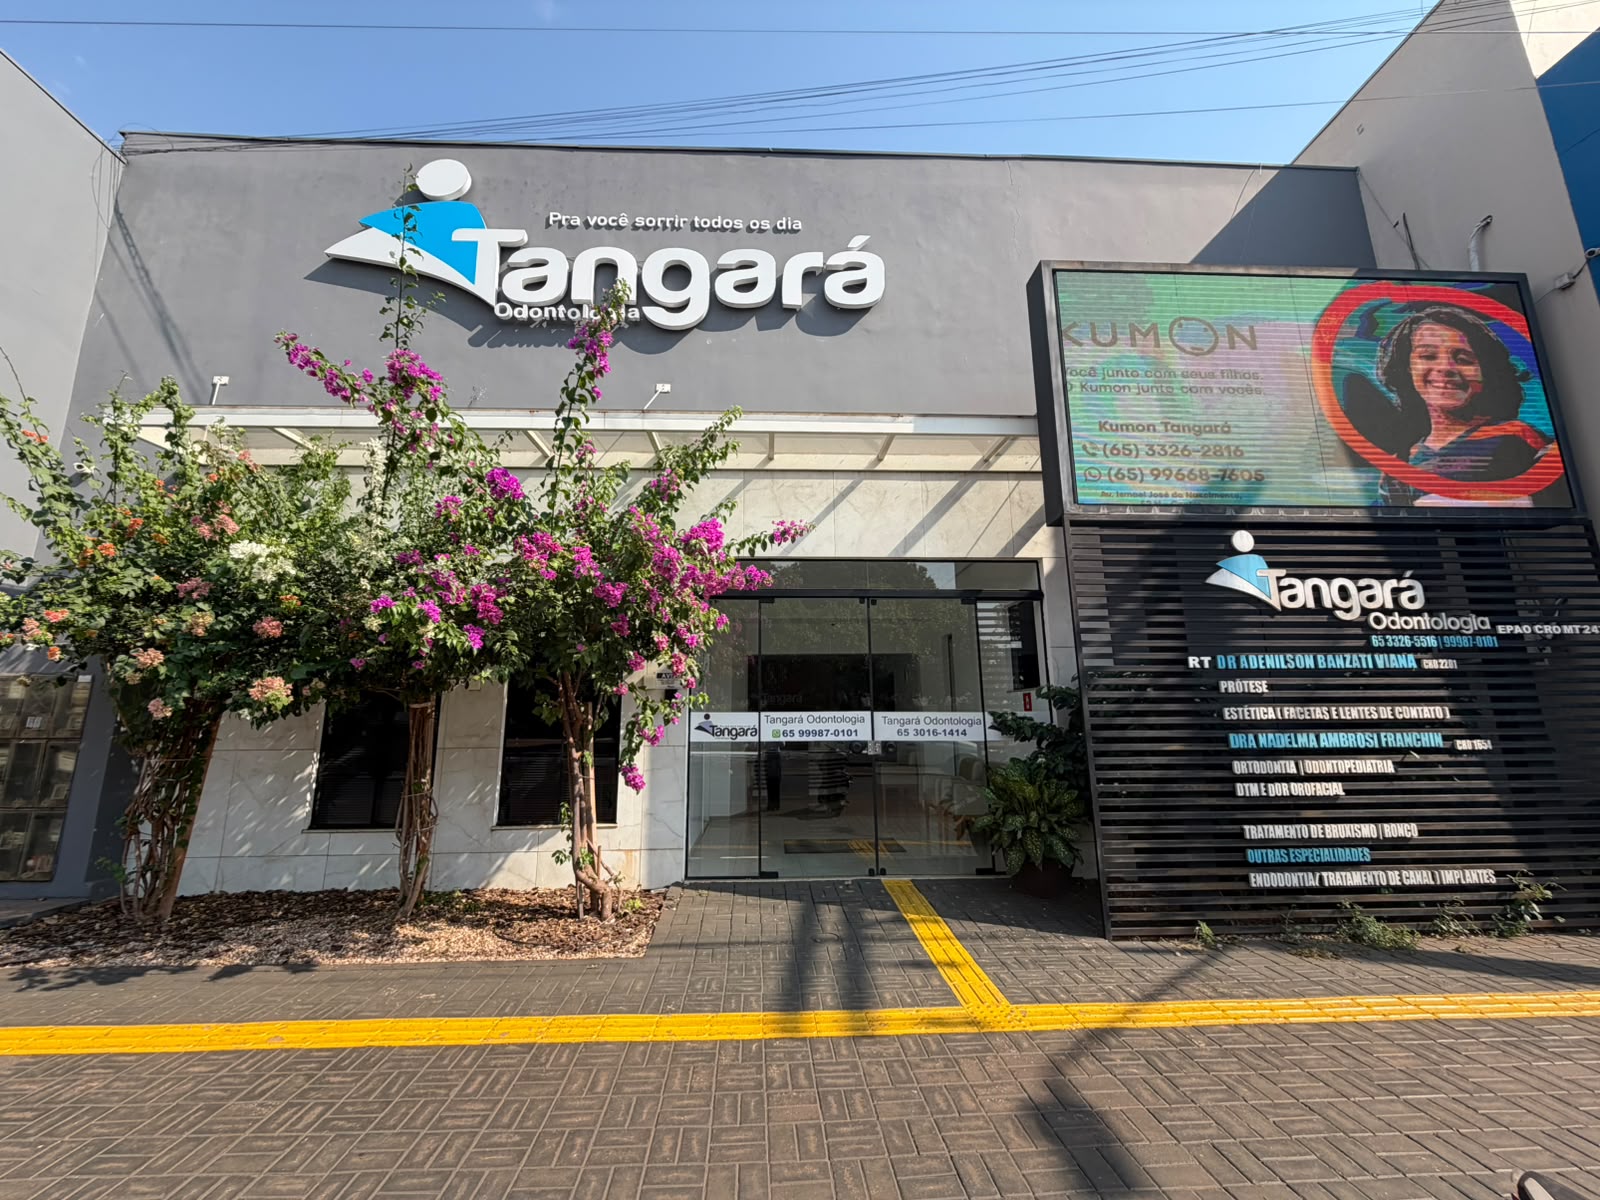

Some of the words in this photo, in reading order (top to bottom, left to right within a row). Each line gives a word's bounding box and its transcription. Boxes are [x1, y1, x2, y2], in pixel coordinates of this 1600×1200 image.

[549, 211, 581, 226] Pra
[586, 212, 629, 227] você
[634, 214, 688, 228] sorrir
[693, 215, 743, 230] todos
[749, 217, 771, 230] os
[776, 216, 803, 231] dia
[451, 229, 886, 331] Tangará
[1102, 367, 1140, 380] junto
[1144, 369, 1177, 379] com
[1181, 370, 1216, 379] seus
[1080, 382, 1131, 393] Kumon
[1136, 383, 1174, 395] junto
[1180, 385, 1213, 394] com
[1098, 420, 1157, 433] Kumon
[1160, 420, 1232, 436] Tangará
[1102, 443, 1139, 458] (65)
[1145, 444, 1244, 458] 3326-2816
[1107, 467, 1144, 483] (65)
[1150, 467, 1265, 482] 99668-7605
[1255, 568, 1425, 621] Tangará
[1368, 612, 1491, 634] Odontologia
[1496, 624, 1532, 634] EPAO
[1534, 624, 1561, 634] CRO
[1563, 624, 1581, 634] MT
[1371, 635, 1386, 648] 65
[1386, 635, 1437, 648] 3326-5516
[1443, 635, 1498, 648] 99987-0101
[1187, 656, 1211, 669] RT
[1216, 654, 1238, 669] DR
[1239, 654, 1315, 669] ADENILSON
[1316, 653, 1373, 669] BANZATI
[1374, 653, 1417, 669] VIANA
[764, 714, 804, 725] Tangará
[806, 714, 865, 725] Odontologia
[1223, 704, 1276, 720] ESTÉTICA
[1283, 706, 1330, 720] FACETAS
[1330, 706, 1339, 720] E
[1339, 706, 1378, 720] LENTES
[1379, 706, 1394, 719] DE
[1395, 706, 1443, 719] CONTATO
[881, 715, 921, 728] Tangará
[923, 715, 982, 728] Odontologia
[708, 724, 758, 741] Tangará
[782, 729, 795, 738] 65
[798, 728, 858, 738] 99987-0101
[896, 728, 910, 737] 65
[913, 728, 967, 737] 3016-1414
[1229, 732, 1257, 749] DRA
[1258, 732, 1318, 748] NADELMA
[1319, 732, 1379, 748] AMBROSI
[1380, 732, 1444, 748] FRANCHIN
[1232, 760, 1298, 774] ORTODONTIA
[1304, 759, 1395, 774] ODONTOPEDIATRIA
[1235, 782, 1260, 797] DTM
[1260, 782, 1267, 796] E
[1267, 782, 1290, 796] DOR
[1290, 782, 1345, 796] OROFACIAL
[1242, 824, 1309, 839] TRATAMENTO
[1310, 824, 1325, 838] DE
[1325, 823, 1377, 838] BRUXISMO
[1383, 822, 1419, 838] RONCO
[1247, 848, 1289, 863] OUTRAS
[1289, 847, 1371, 862] ESPECIALIDADES
[1321, 870, 1387, 887] TRATAMENTO
[1386, 870, 1401, 886] DE
[1401, 870, 1435, 885] CANAL
[1440, 868, 1497, 884] IMPLANTES
